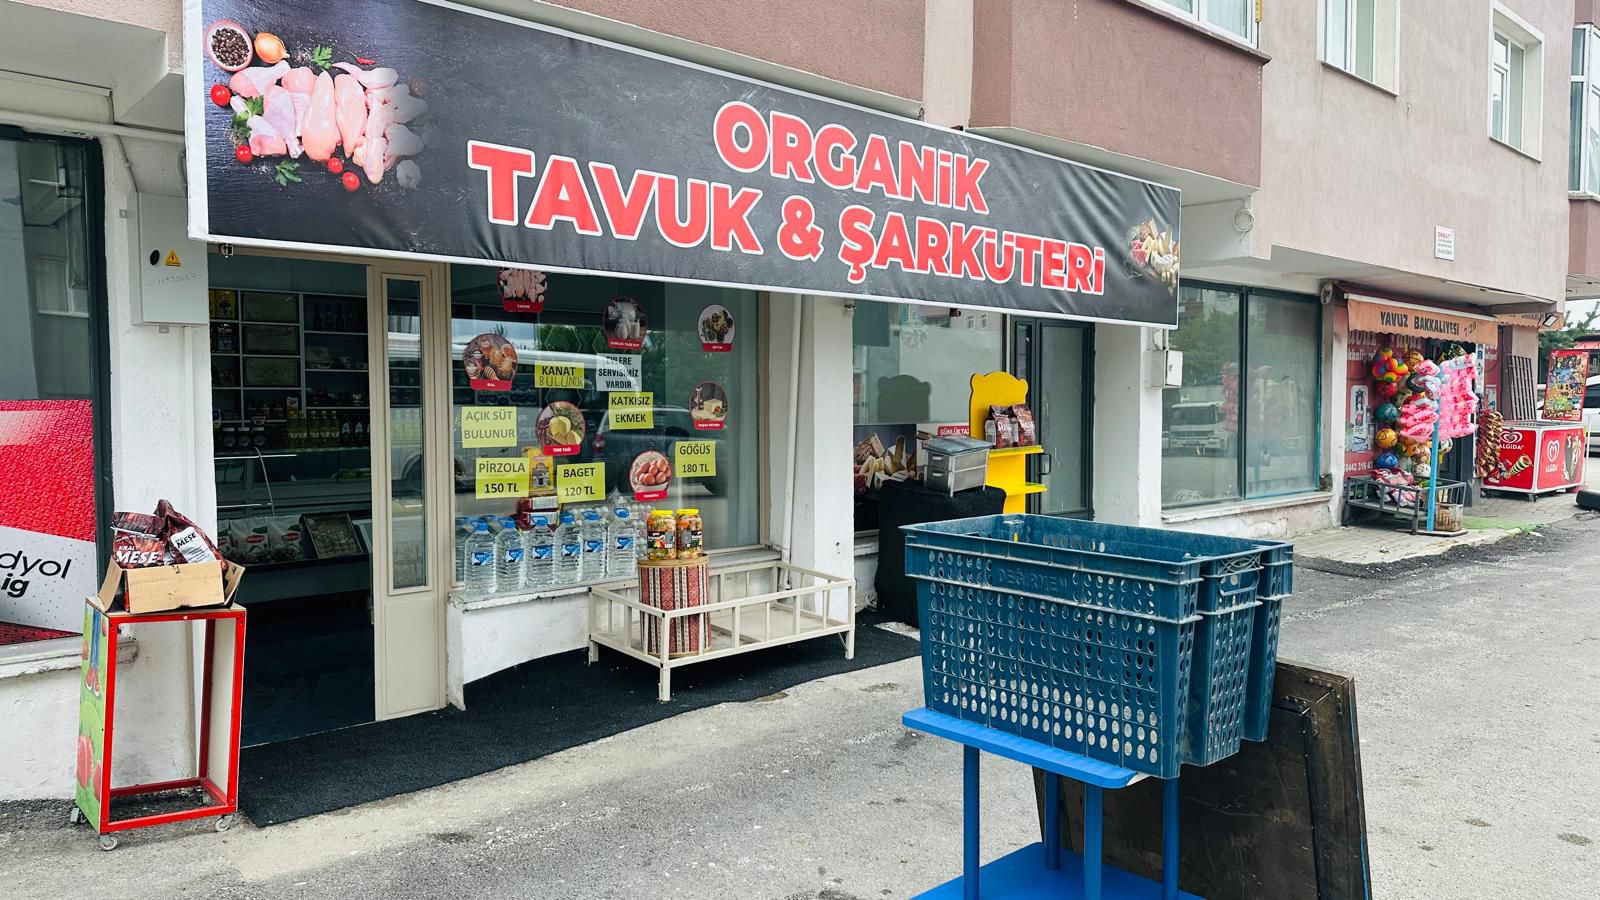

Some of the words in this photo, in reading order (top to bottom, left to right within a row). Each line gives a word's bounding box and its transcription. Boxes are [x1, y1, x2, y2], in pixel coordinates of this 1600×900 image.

[714, 102, 989, 213] ORGANİK
[468, 141, 763, 254] TAVUK
[777, 196, 824, 260] &
[838, 205, 1107, 296] ŞARKÜTERİ
[1380, 311, 1408, 328] YAVUZ
[542, 366, 576, 376] KANAT
[605, 380, 632, 389] VARDIR
[611, 396, 650, 406] KATKISIZ
[466, 410, 490, 423] AÇIK
[492, 408, 513, 421] SÜT
[615, 413, 646, 423] EKMEK
[464, 429, 516, 440] BULUNUR
[679, 443, 711, 455] GÖĞÜS
[479, 460, 526, 473] PİRZOLA
[563, 467, 596, 478] BAGET
[682, 463, 698, 473] 180
[699, 463, 709, 473] TL
[484, 483, 504, 494] 150
[507, 482, 519, 493] TL
[565, 487, 582, 497] 120
[584, 485, 596, 495] TL
